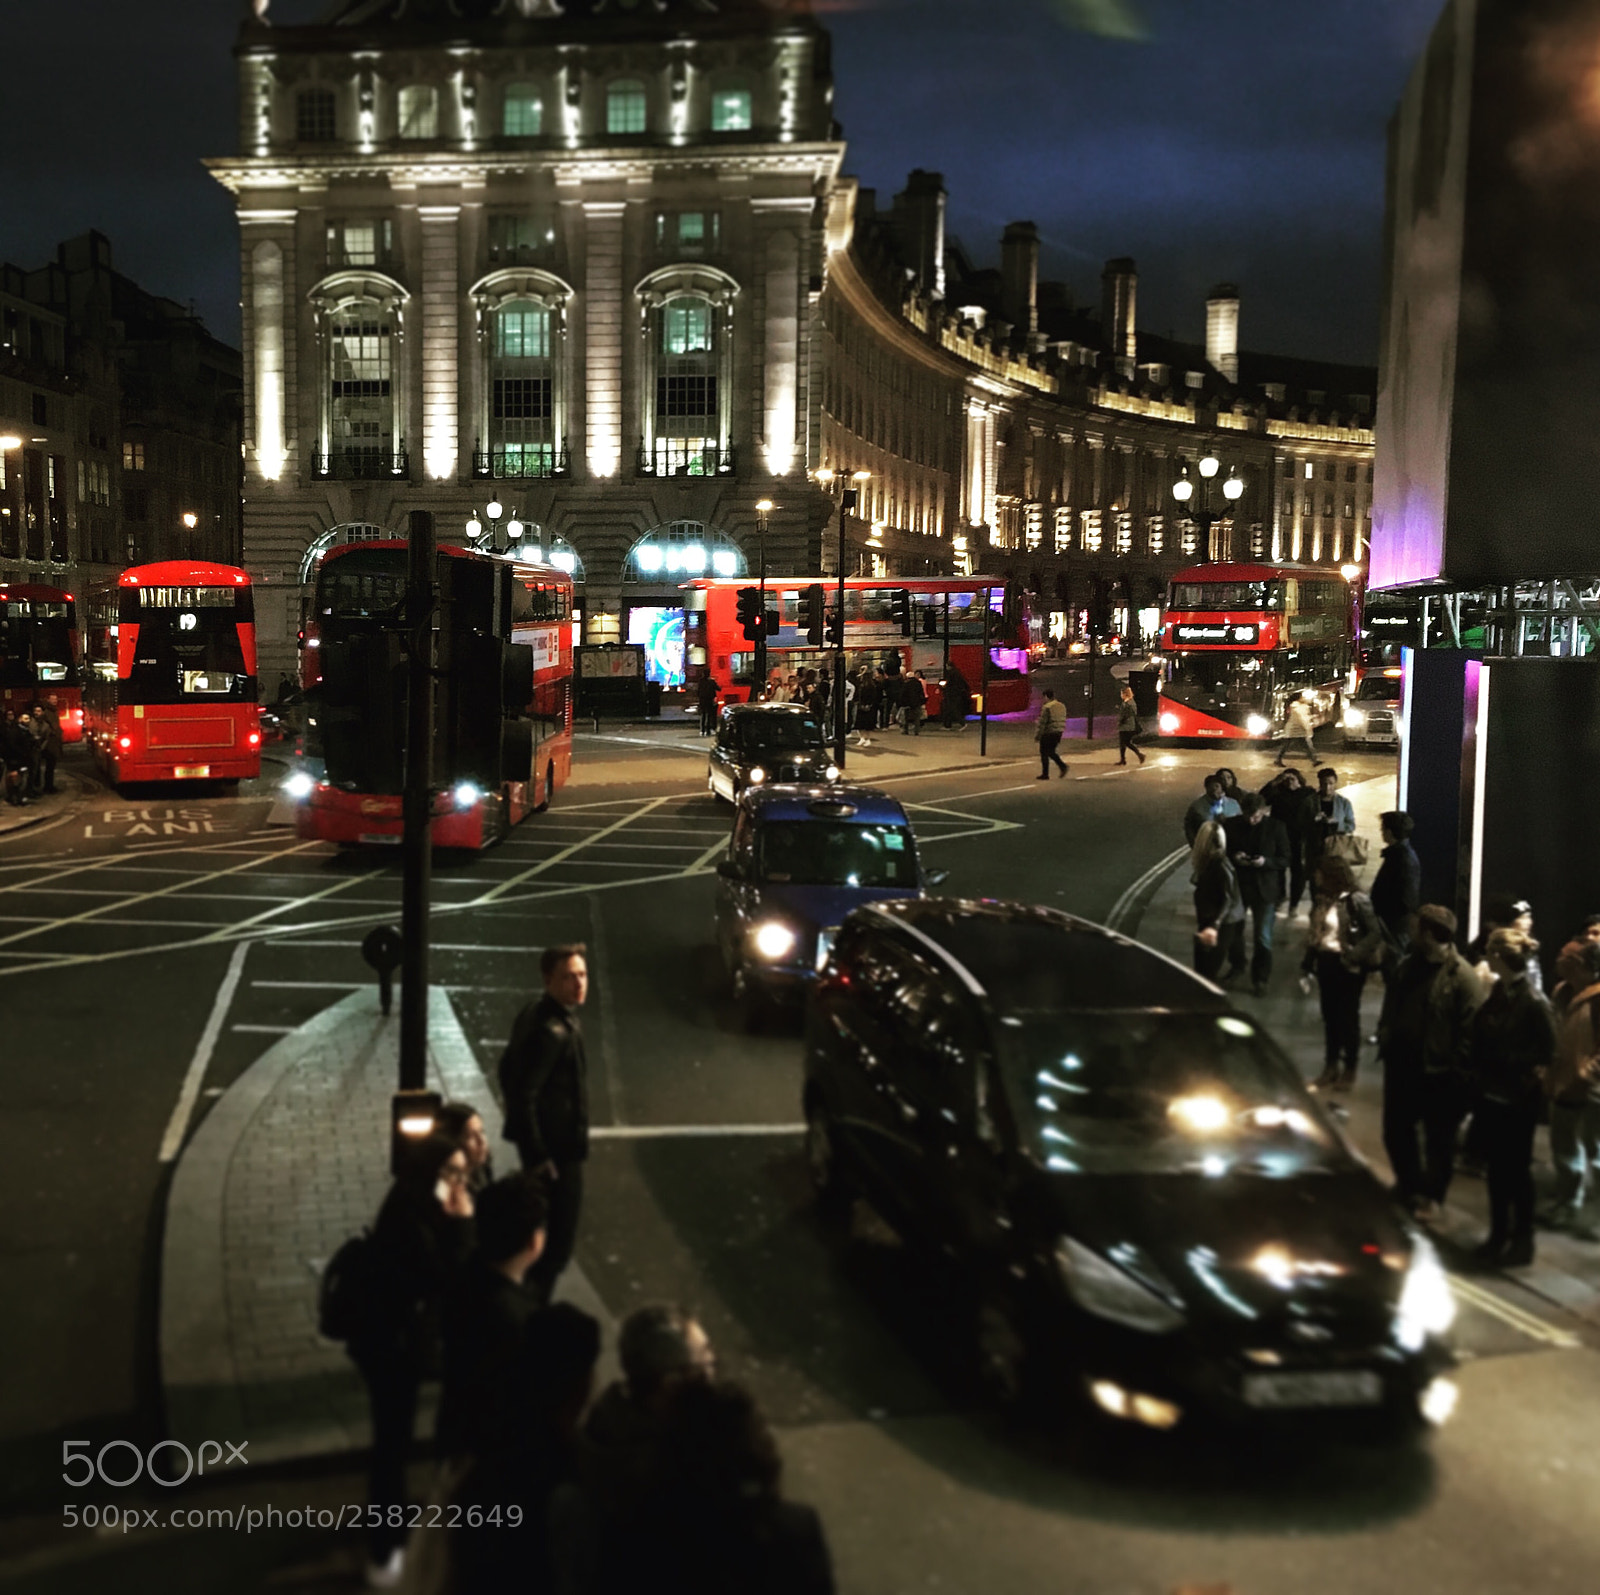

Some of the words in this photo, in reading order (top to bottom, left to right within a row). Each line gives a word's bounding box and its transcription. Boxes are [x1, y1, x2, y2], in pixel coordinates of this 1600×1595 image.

[180, 613, 197, 630] 19
[103, 809, 213, 823] BUS
[84, 820, 238, 839] LANE
